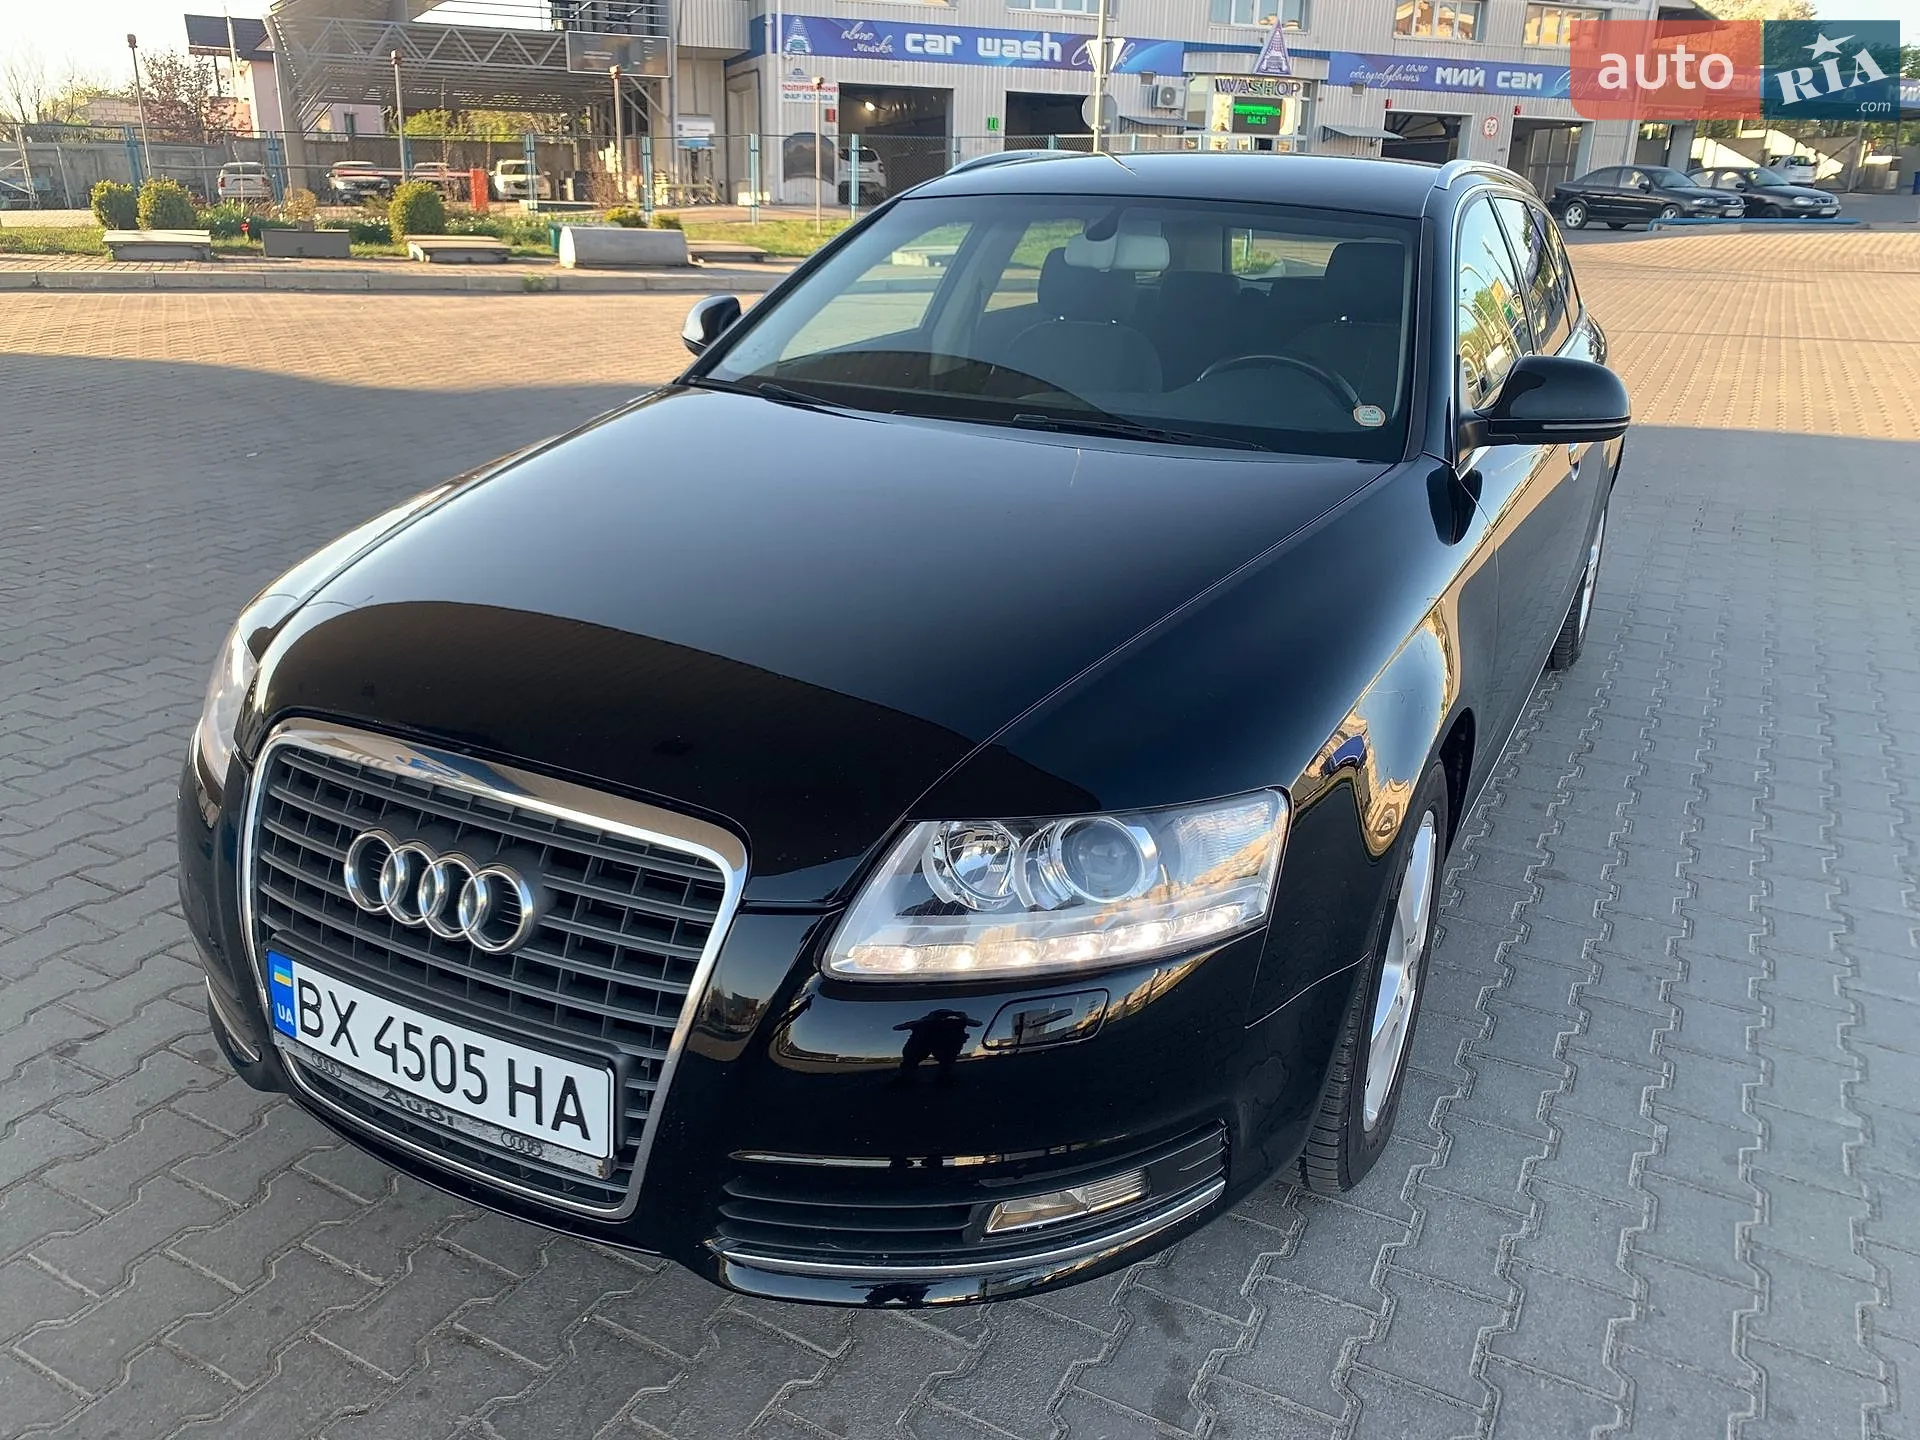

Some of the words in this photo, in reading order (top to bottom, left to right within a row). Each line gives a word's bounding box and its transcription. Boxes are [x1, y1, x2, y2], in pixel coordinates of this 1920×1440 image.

[904, 32, 962, 56] car
[976, 32, 1062, 63] wash
[1215, 78, 1301, 96] WASHOP
[276, 1001, 296, 1025] UA
[374, 1015, 489, 1105] 4505
